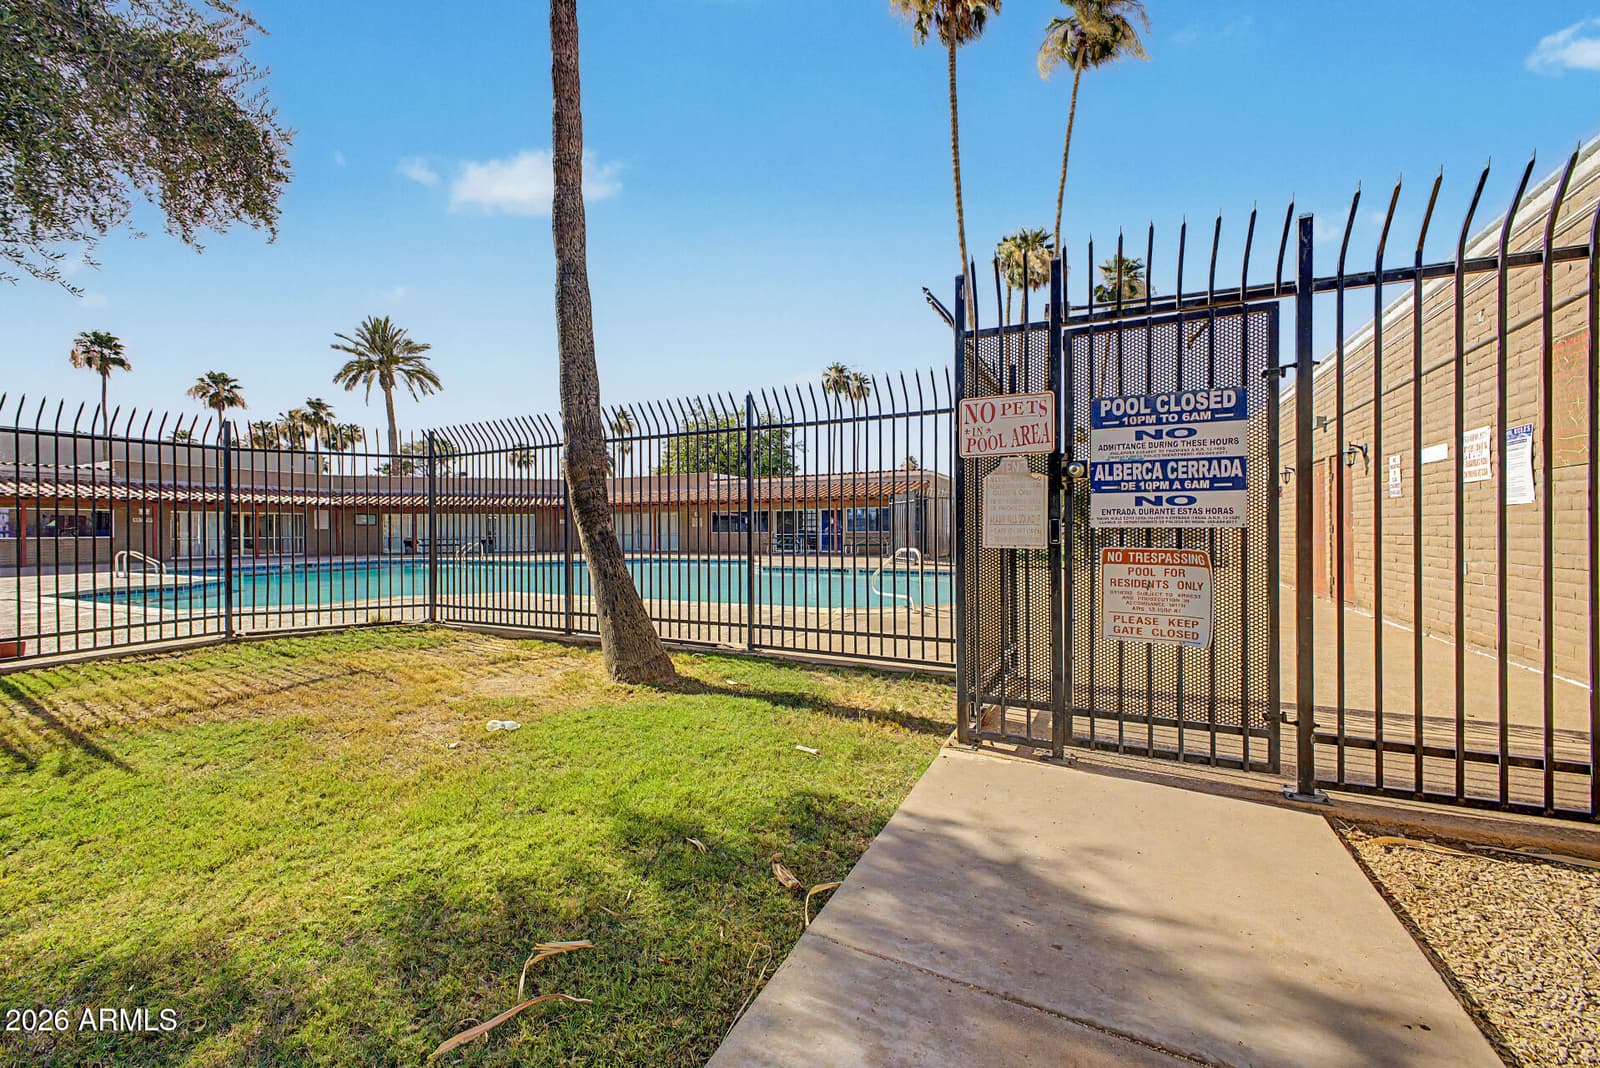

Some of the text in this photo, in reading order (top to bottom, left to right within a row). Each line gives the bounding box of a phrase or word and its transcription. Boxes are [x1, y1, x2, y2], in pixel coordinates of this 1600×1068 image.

[1100, 390, 1237, 417] POOL CLOSED
[964, 400, 1048, 424] NO PETS
[1122, 411, 1212, 426] 10PM TO 6AM
[966, 421, 1053, 453] POOL AREA
[972, 426, 983, 436] IN
[1134, 427, 1198, 441] NO
[1098, 441, 1146, 452] ADMITTANCE
[1148, 440, 1179, 449] DURING
[1181, 438, 1207, 447] THESE
[1209, 437, 1239, 446] HOURS
[1094, 458, 1243, 482] ALBERCA CERRADA
[1121, 480, 1210, 491] DE 10PM A 6AM
[1134, 495, 1198, 507] NO
[1101, 508, 1136, 516] ENTRADA
[1177, 507, 1203, 515] ESTAS
[1107, 551, 1205, 566] NO TRESPASSING
[1127, 567, 1186, 578] POOL FOR
[1109, 578, 1204, 591] RESIDENTS ONLY
[1113, 615, 1199, 628] PLEASE KEEP
[1113, 626, 1199, 640] GATE CLOSED
